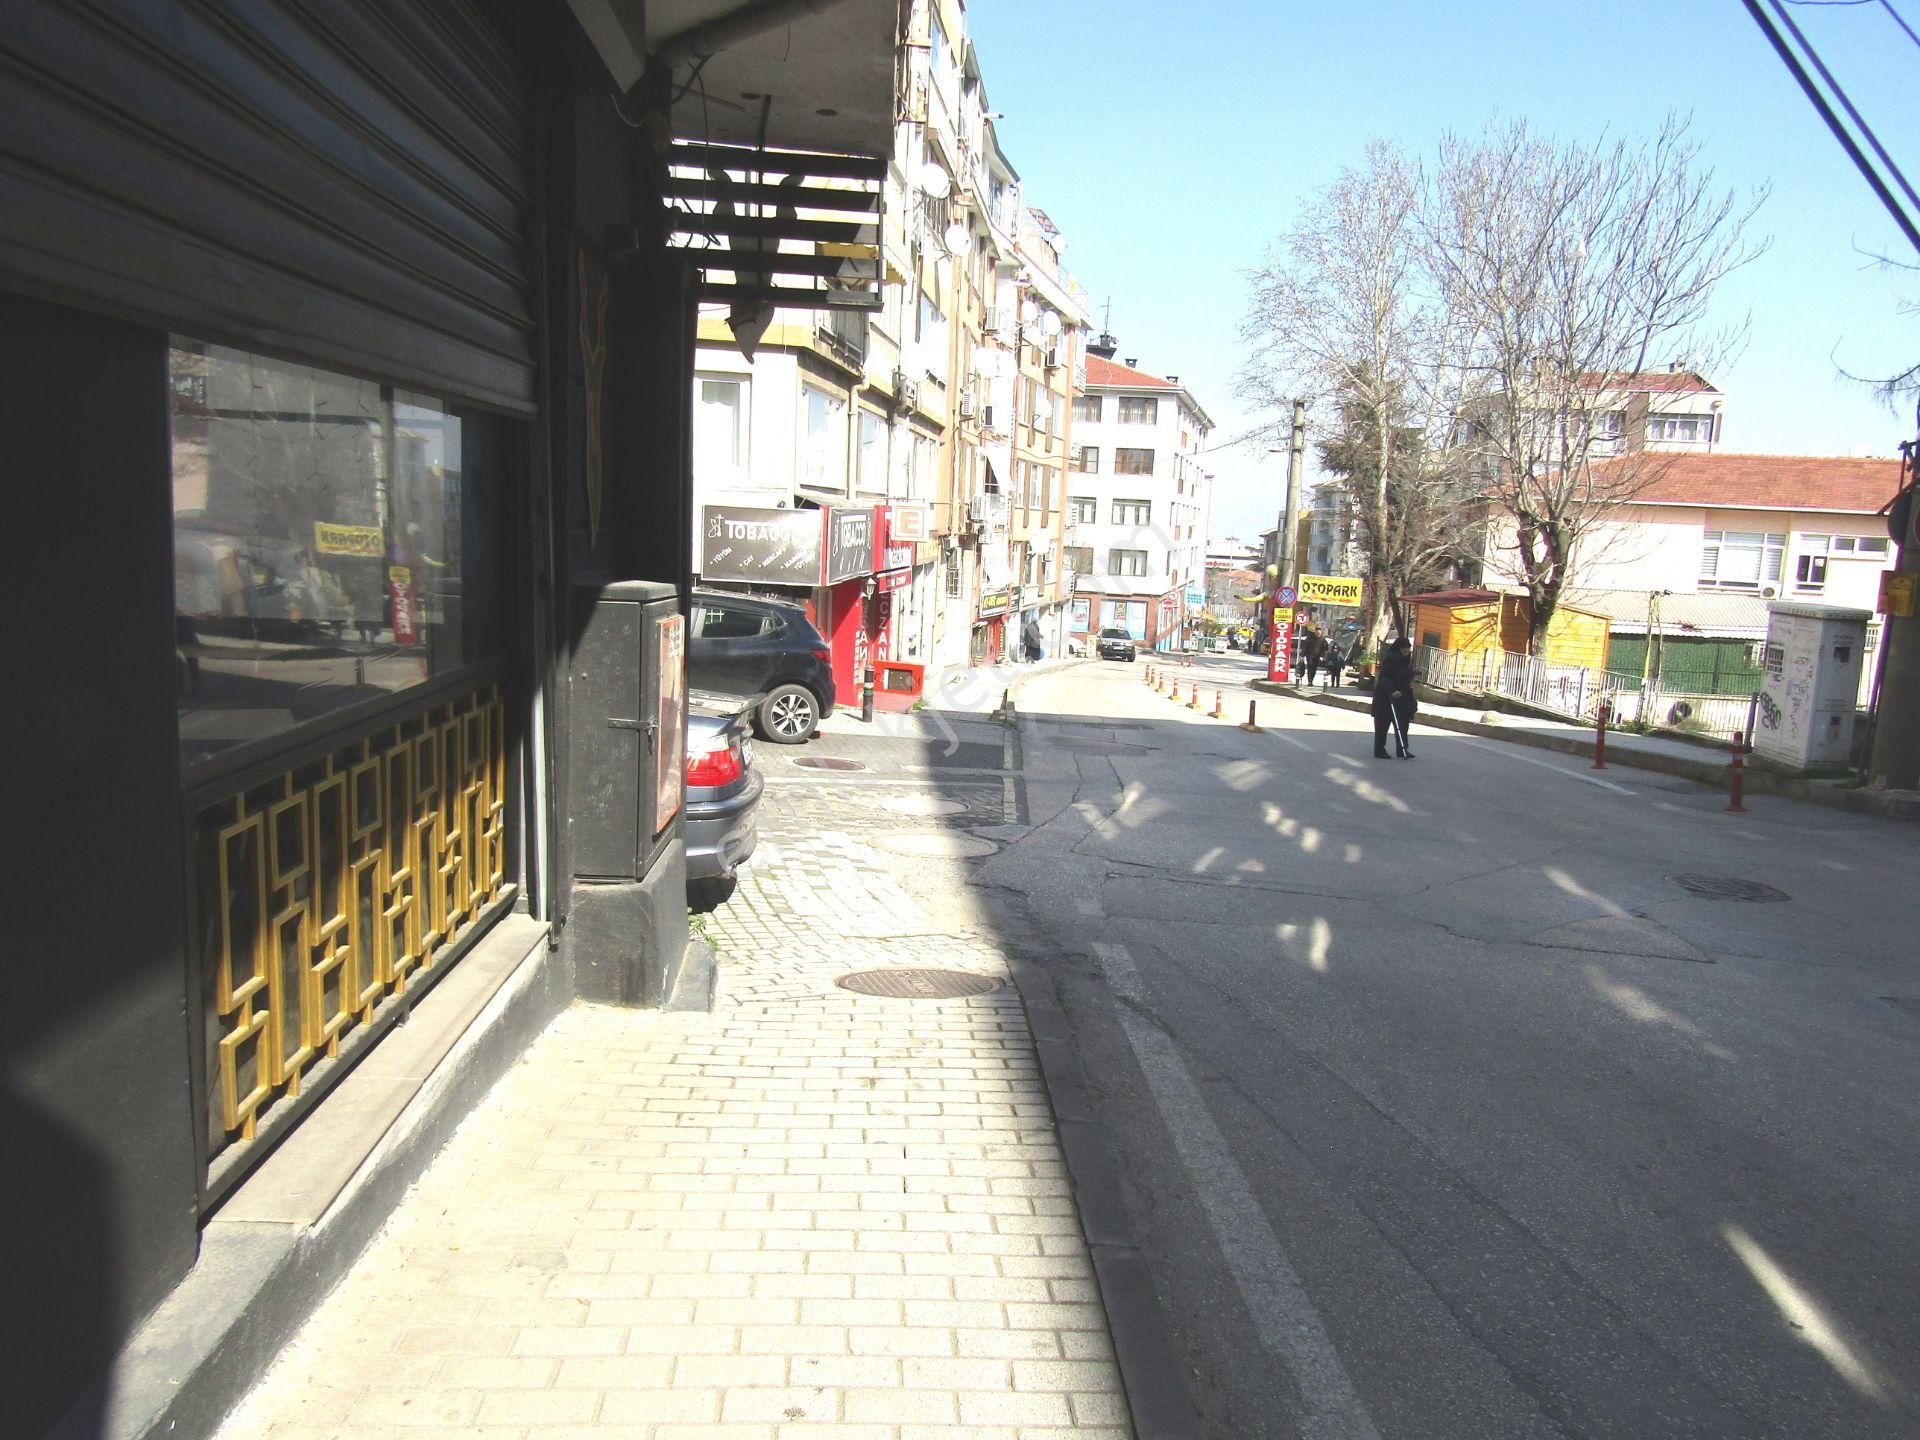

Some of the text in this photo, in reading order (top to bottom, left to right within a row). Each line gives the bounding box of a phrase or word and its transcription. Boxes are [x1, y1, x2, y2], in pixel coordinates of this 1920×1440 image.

[725, 519, 803, 541] TOBACC
[840, 514, 867, 549] TOBACCO
[901, 511, 919, 533] E
[1302, 581, 1358, 598] OTOPARK
[1274, 622, 1289, 673] OTOPARK
